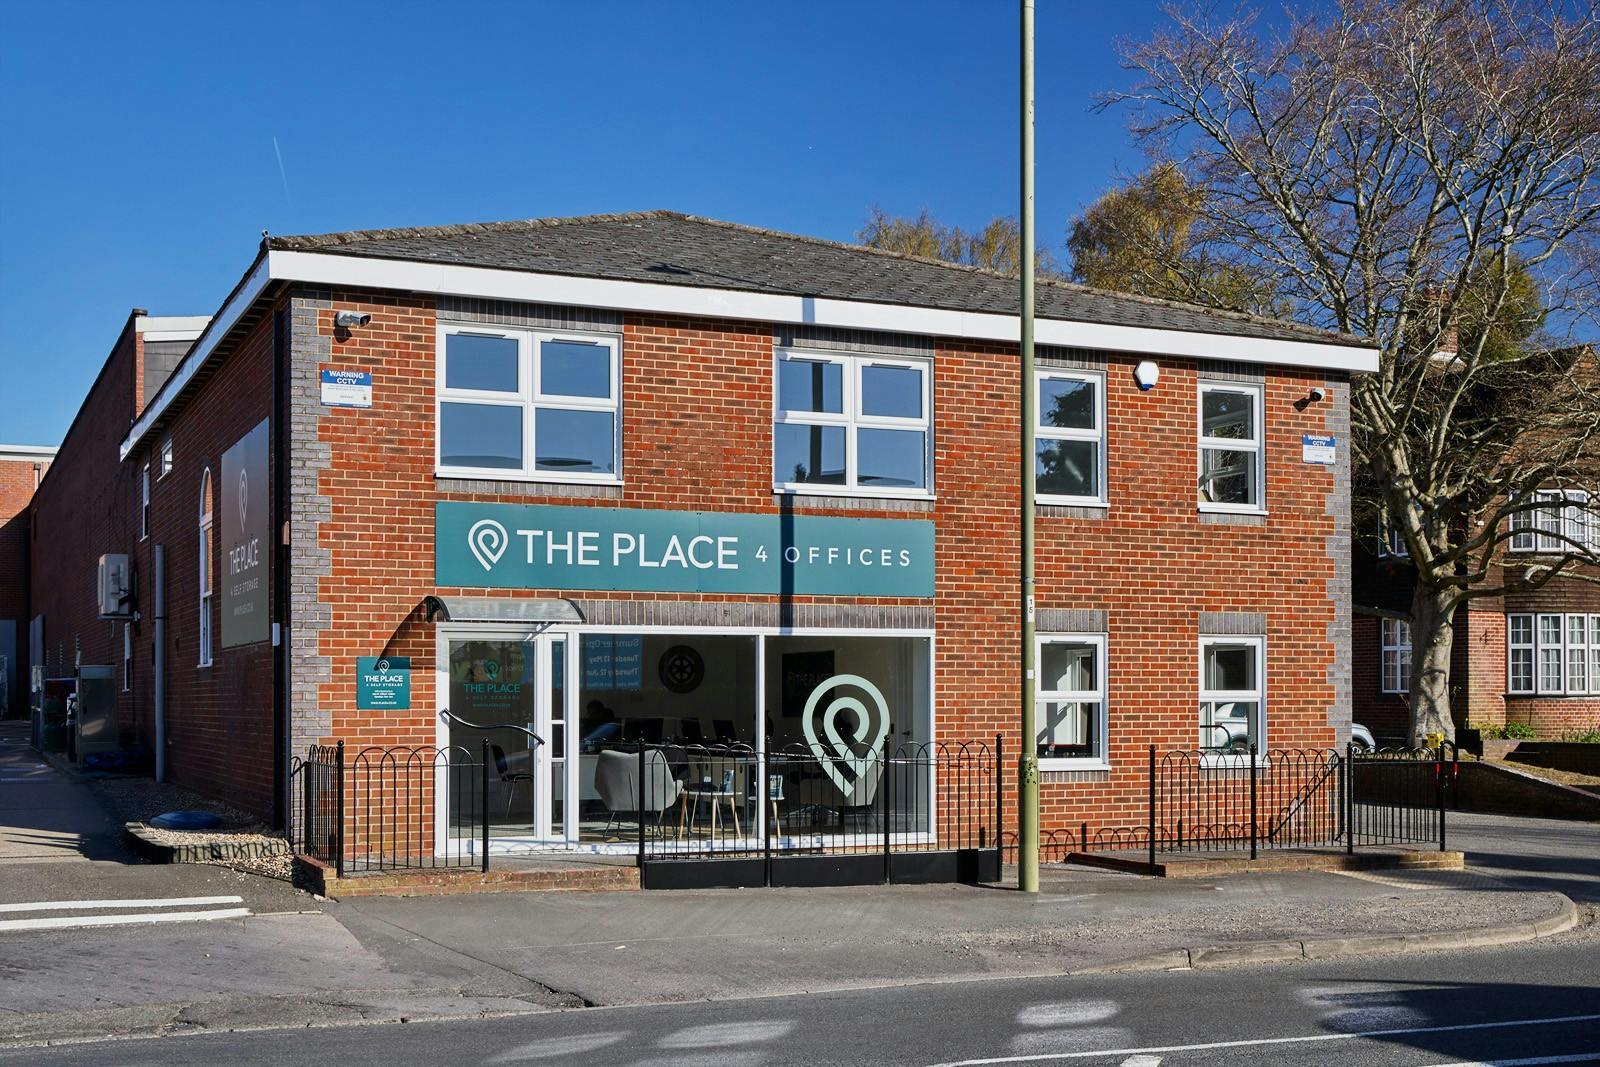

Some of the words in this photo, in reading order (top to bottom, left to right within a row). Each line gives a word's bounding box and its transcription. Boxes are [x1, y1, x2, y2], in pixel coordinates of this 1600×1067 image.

[329, 371, 364, 379] WARNING
[516, 529, 600, 566] THE
[612, 532, 739, 570] PLACE
[755, 545, 768, 563] 4
[784, 546, 911, 567] OFFICES
[229, 547, 241, 576] THE
[240, 538, 259, 572] PLACE
[364, 675, 380, 683] THE
[380, 675, 404, 683] PLACE
[464, 683, 485, 693] THE
[487, 683, 521, 693] PLACE
